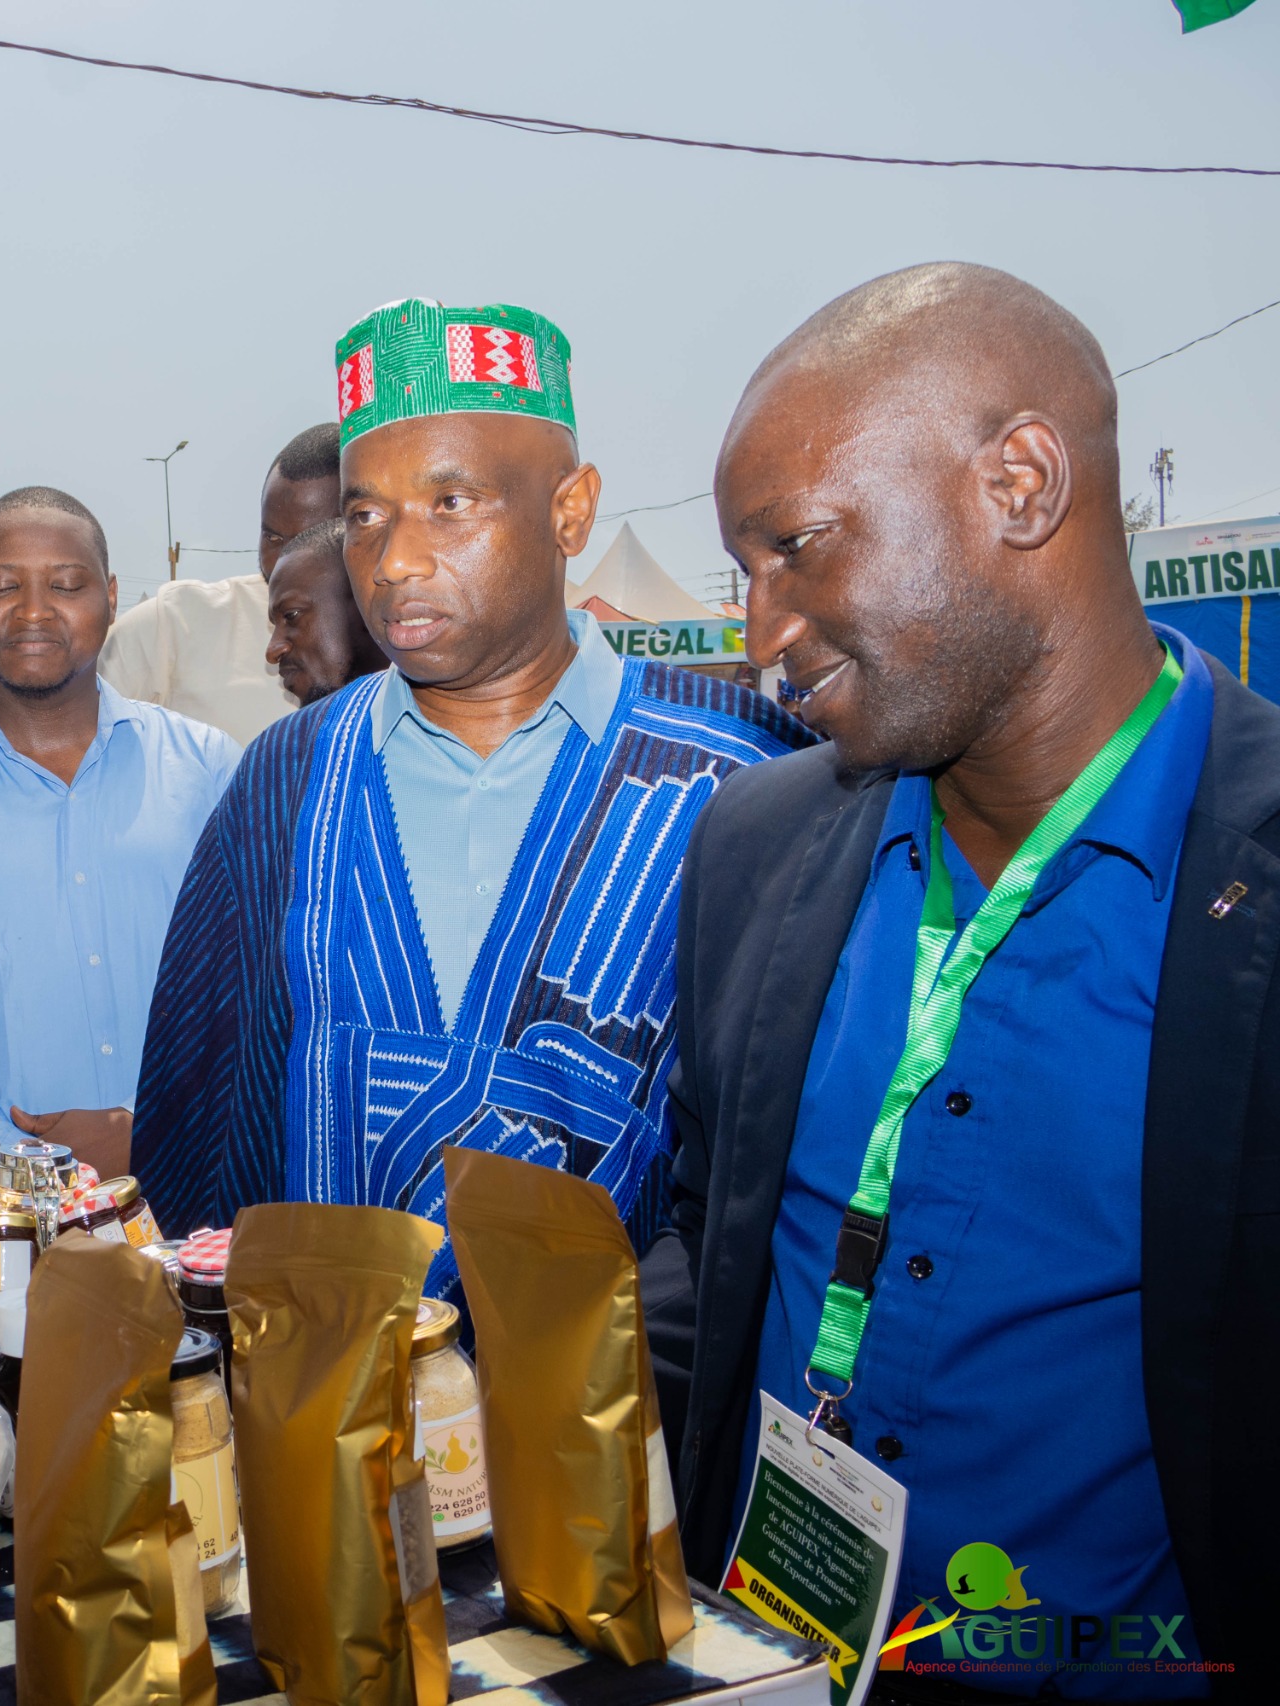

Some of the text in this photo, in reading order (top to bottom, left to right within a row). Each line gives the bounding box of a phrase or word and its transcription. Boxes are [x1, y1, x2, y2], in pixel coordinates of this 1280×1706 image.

[602, 628, 714, 656] NEGAL
[766, 1443, 789, 1464] NOUVELLE
[426, 1471, 487, 1497] ASM NATUR
[453, 1497, 473, 1509] 628
[475, 1491, 486, 1502] 50
[454, 1501, 486, 1518] 629 01
[764, 1469, 874, 1561] Bienvenue à la cérémonie de
[203, 1538, 215, 1549] 62
[766, 1489, 867, 1575] lancement du site internet
[768, 1509, 778, 1524] de
[779, 1518, 820, 1557] AGUIPEX
[205, 1548, 216, 1559] 24
[762, 1523, 857, 1606] Guinéenne de Promotion
[768, 1547, 782, 1563] des
[783, 1562, 832, 1606] Exportations
